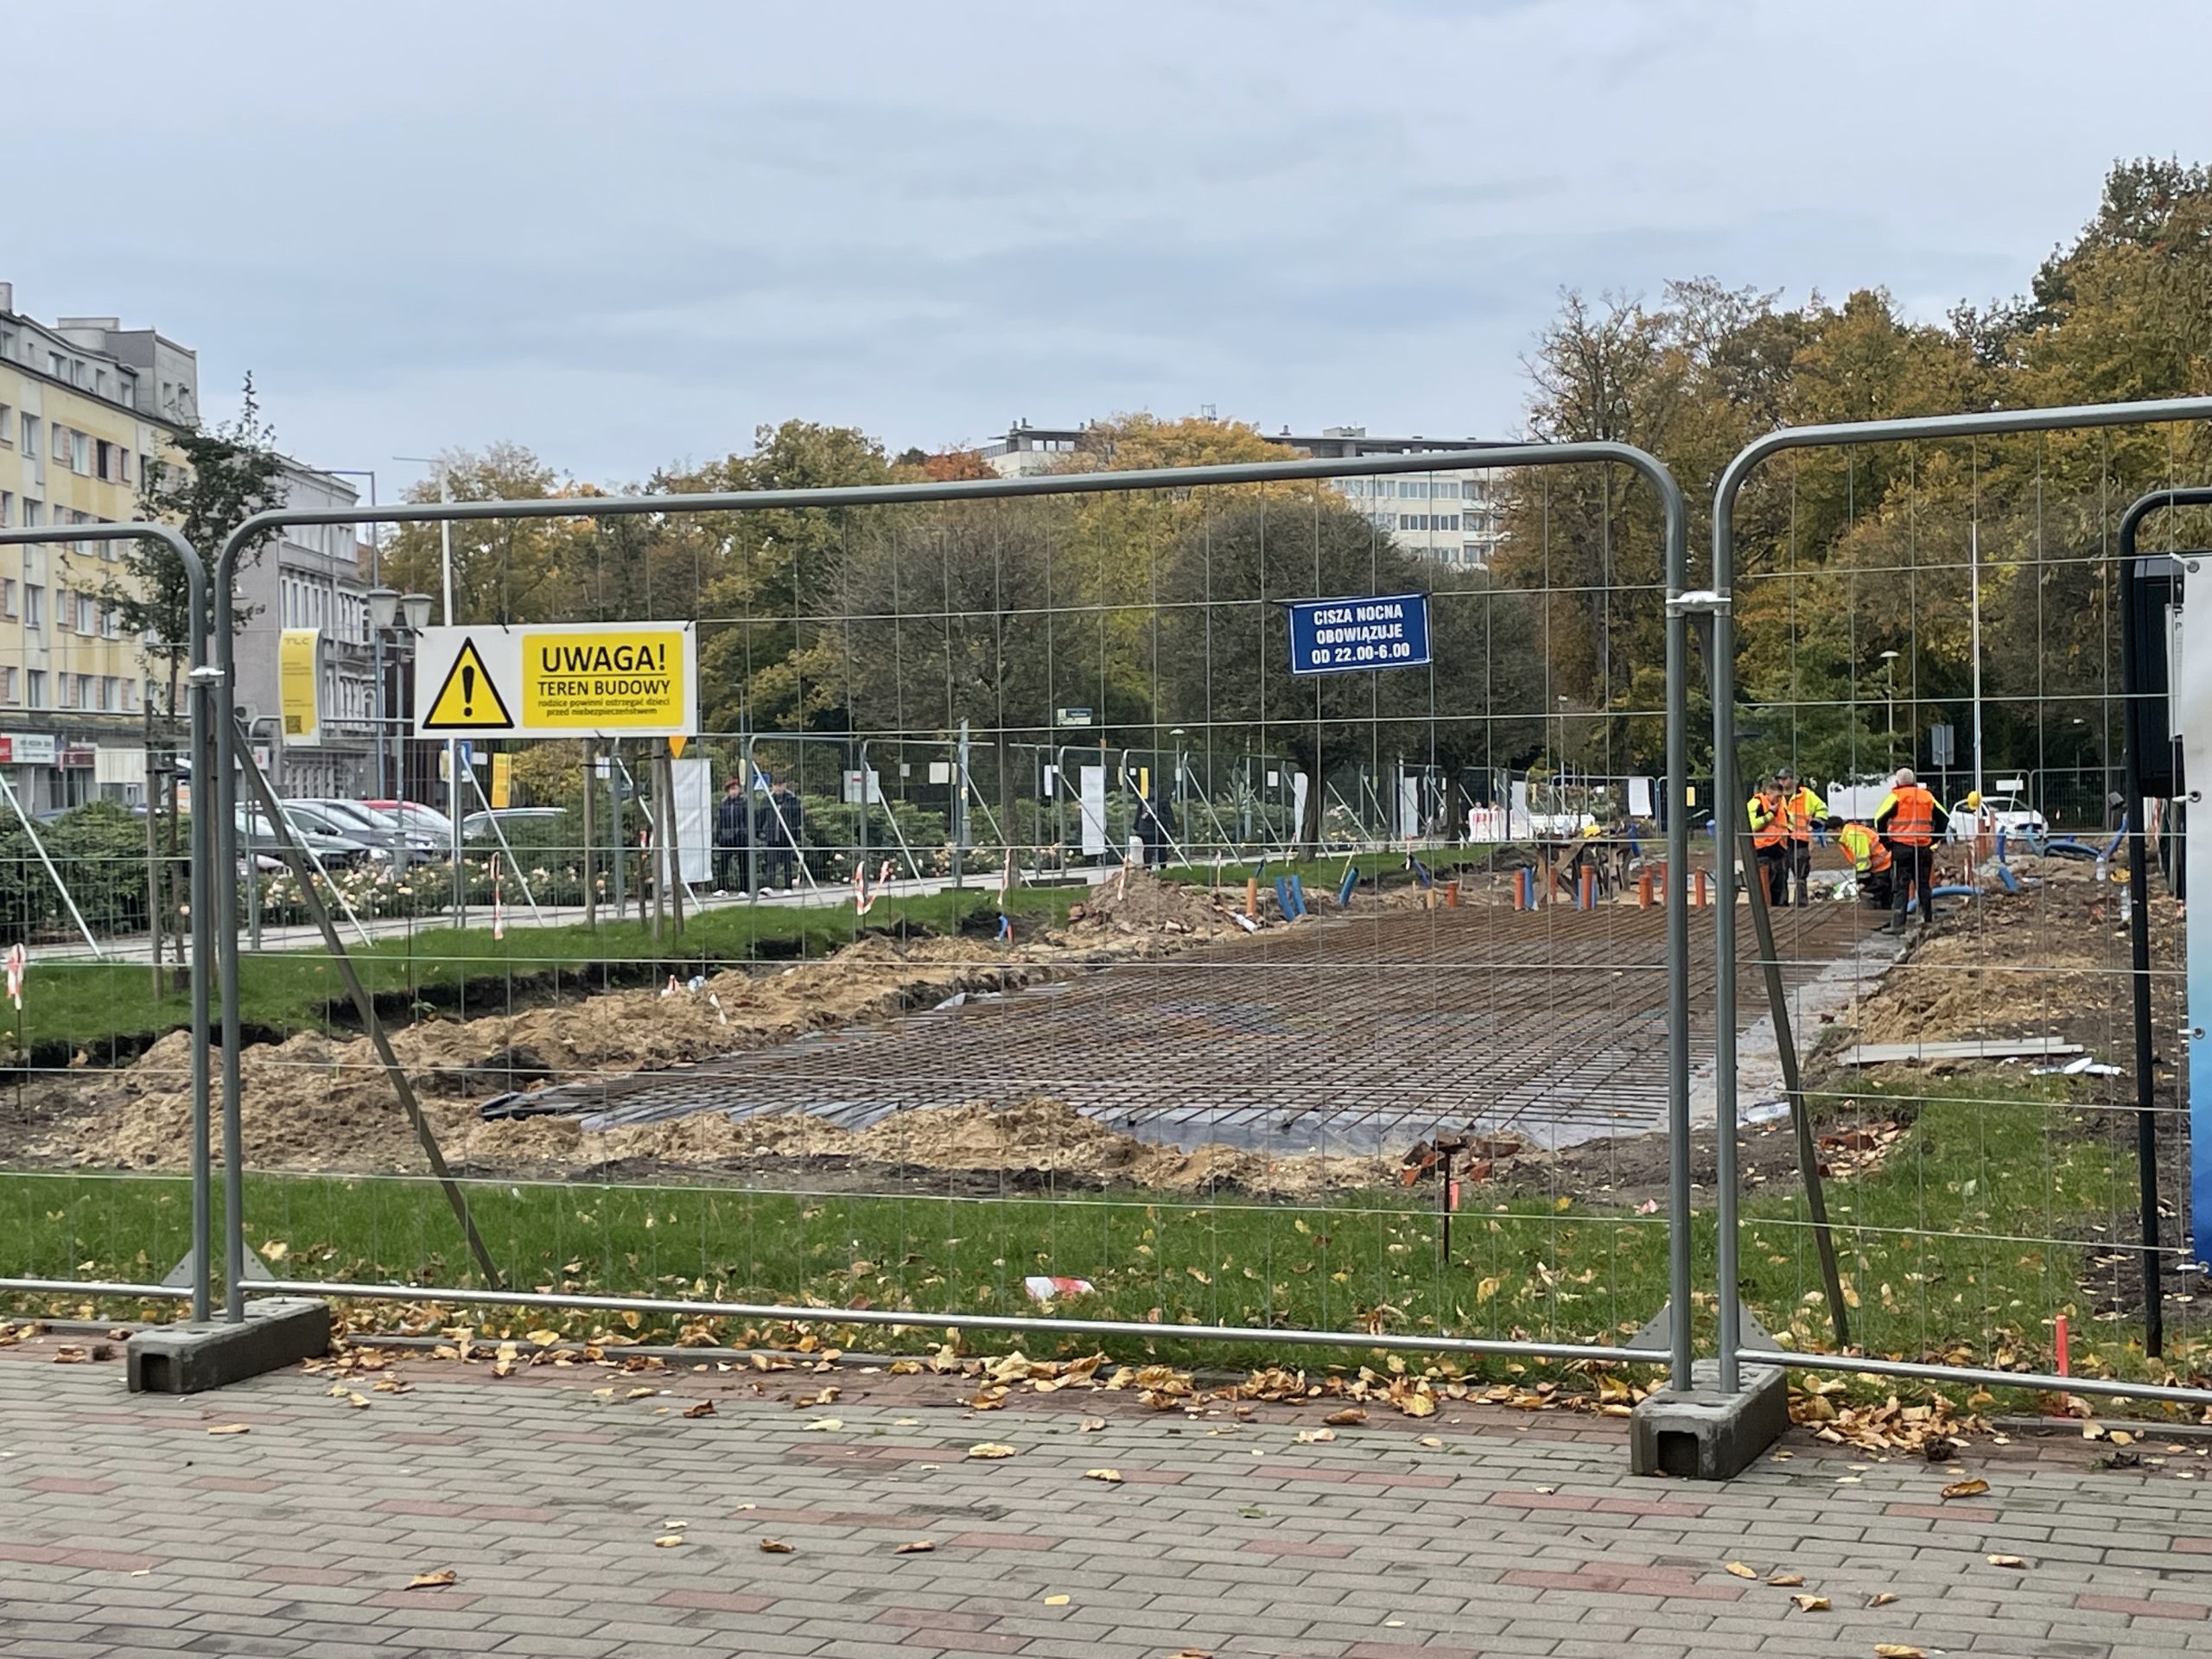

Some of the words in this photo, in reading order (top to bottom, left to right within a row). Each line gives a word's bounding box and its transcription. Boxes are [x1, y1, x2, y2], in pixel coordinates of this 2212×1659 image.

[1313, 608, 1353, 626] CISZA
[1356, 604, 1403, 622] NOCNA
[1316, 623, 1403, 644] OBOWIĄZUJE
[542, 643, 665, 672] UWAGA!
[1312, 649, 1331, 664] OD
[1334, 642, 1410, 663] 22.00-6.00
[537, 681, 588, 696] TEREN
[594, 679, 671, 695] BUDOWY
[546, 708, 569, 717] przed
[569, 698, 603, 708] powinni
[646, 697, 670, 706] dzieci
